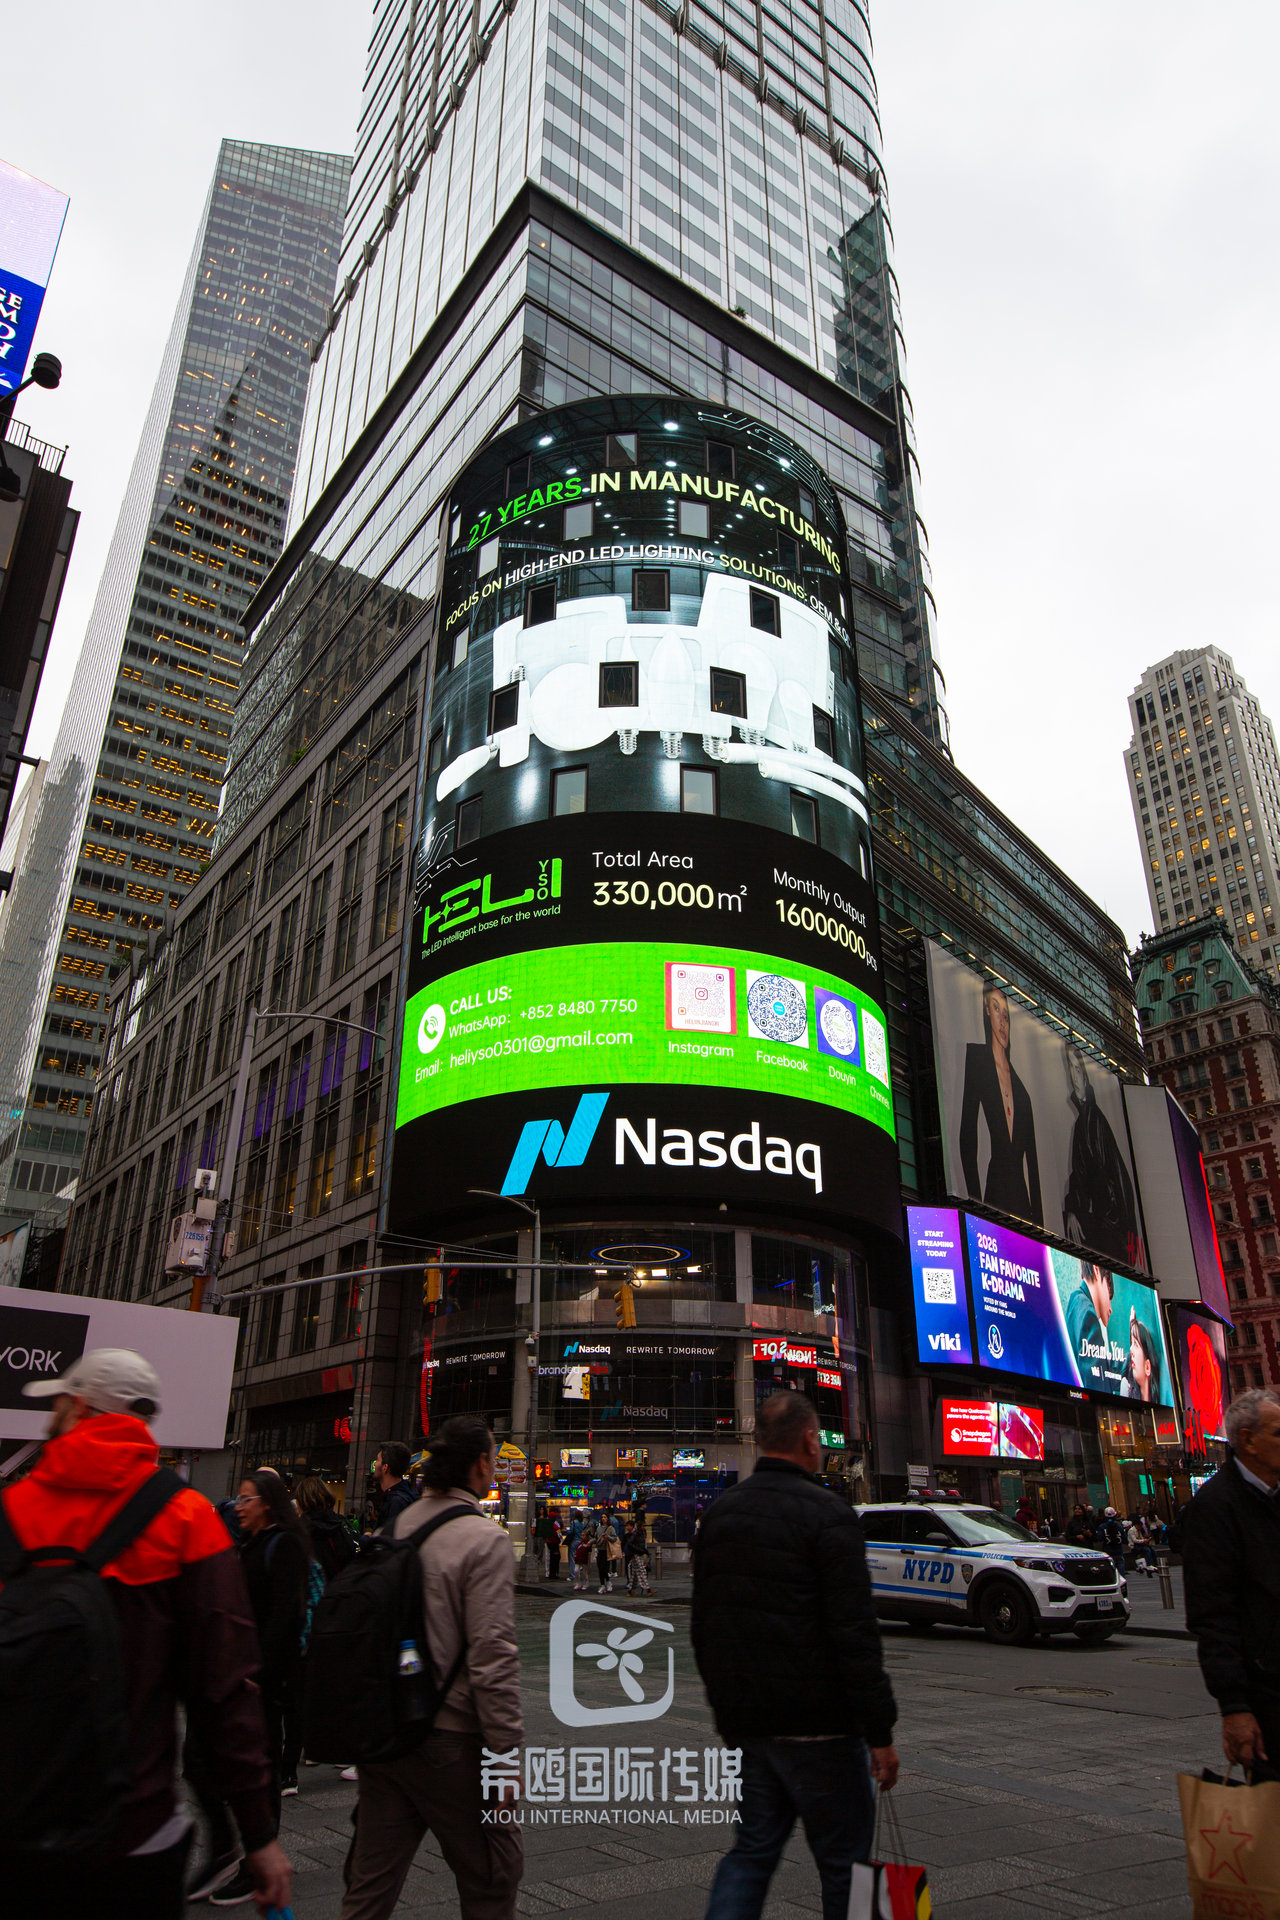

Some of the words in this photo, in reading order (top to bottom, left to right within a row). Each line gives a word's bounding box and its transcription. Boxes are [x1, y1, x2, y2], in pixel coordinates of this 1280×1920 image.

[469, 513, 492, 548] 27
[497, 477, 582, 524] YEARS
[590, 471, 621, 494] IN
[630, 470, 841, 575] MANUFACTURING
[445, 591, 480, 632] FOCUS
[482, 577, 502, 598] ON
[505, 549, 585, 585] HIGH-END
[590, 545, 624, 561] LED
[629, 544, 715, 564] LIGHTING
[719, 554, 807, 602] SOLUTIONS:
[810, 595, 833, 624] OEM
[592, 850, 641, 868] Total
[647, 851, 694, 869] Area
[773, 867, 830, 906] Monthly
[833, 892, 867, 928] Output
[431, 939, 443, 954] LED
[443, 924, 477, 946] intelligent
[478, 918, 499, 932] base
[500, 914, 514, 926] for
[515, 910, 531, 922] the
[533, 904, 561, 917] world
[450, 992, 483, 1016] CALL
[487, 985, 513, 1003] US:
[519, 1004, 554, 1020] +852
[558, 1000, 595, 1016] 8480
[600, 998, 638, 1014] 7750
[449, 1030, 634, 1069] heliyso0301@gmail.com
[668, 1041, 734, 1059] Instagram
[756, 1050, 809, 1072] Facebook
[828, 1065, 857, 1087] Douyin
[614, 1116, 823, 1195] Nasdaq
[917, 1239, 954, 1248] STREAMING
[924, 1230, 944, 1238] START
[925, 1250, 947, 1258] TODAY
[979, 1251, 999, 1274] FAN
[999, 1257, 1041, 1289] FAVORITE
[980, 1272, 1026, 1302] K-DRAMA
[446, 1353, 468, 1366] REWRITE
[470, 1350, 506, 1363] TOMORROW
[578, 1344, 611, 1356] Nasdaq
[626, 1346, 664, 1354] REWRITE
[667, 1346, 716, 1356] TOMORROW
[1079, 1337, 1106, 1360] Dream
[1110, 1341, 1127, 1362] You
[623, 1404, 668, 1420] Nasdaq
[981, 1552, 1006, 1561] POLICE
[902, 1558, 955, 1585] NYPD
